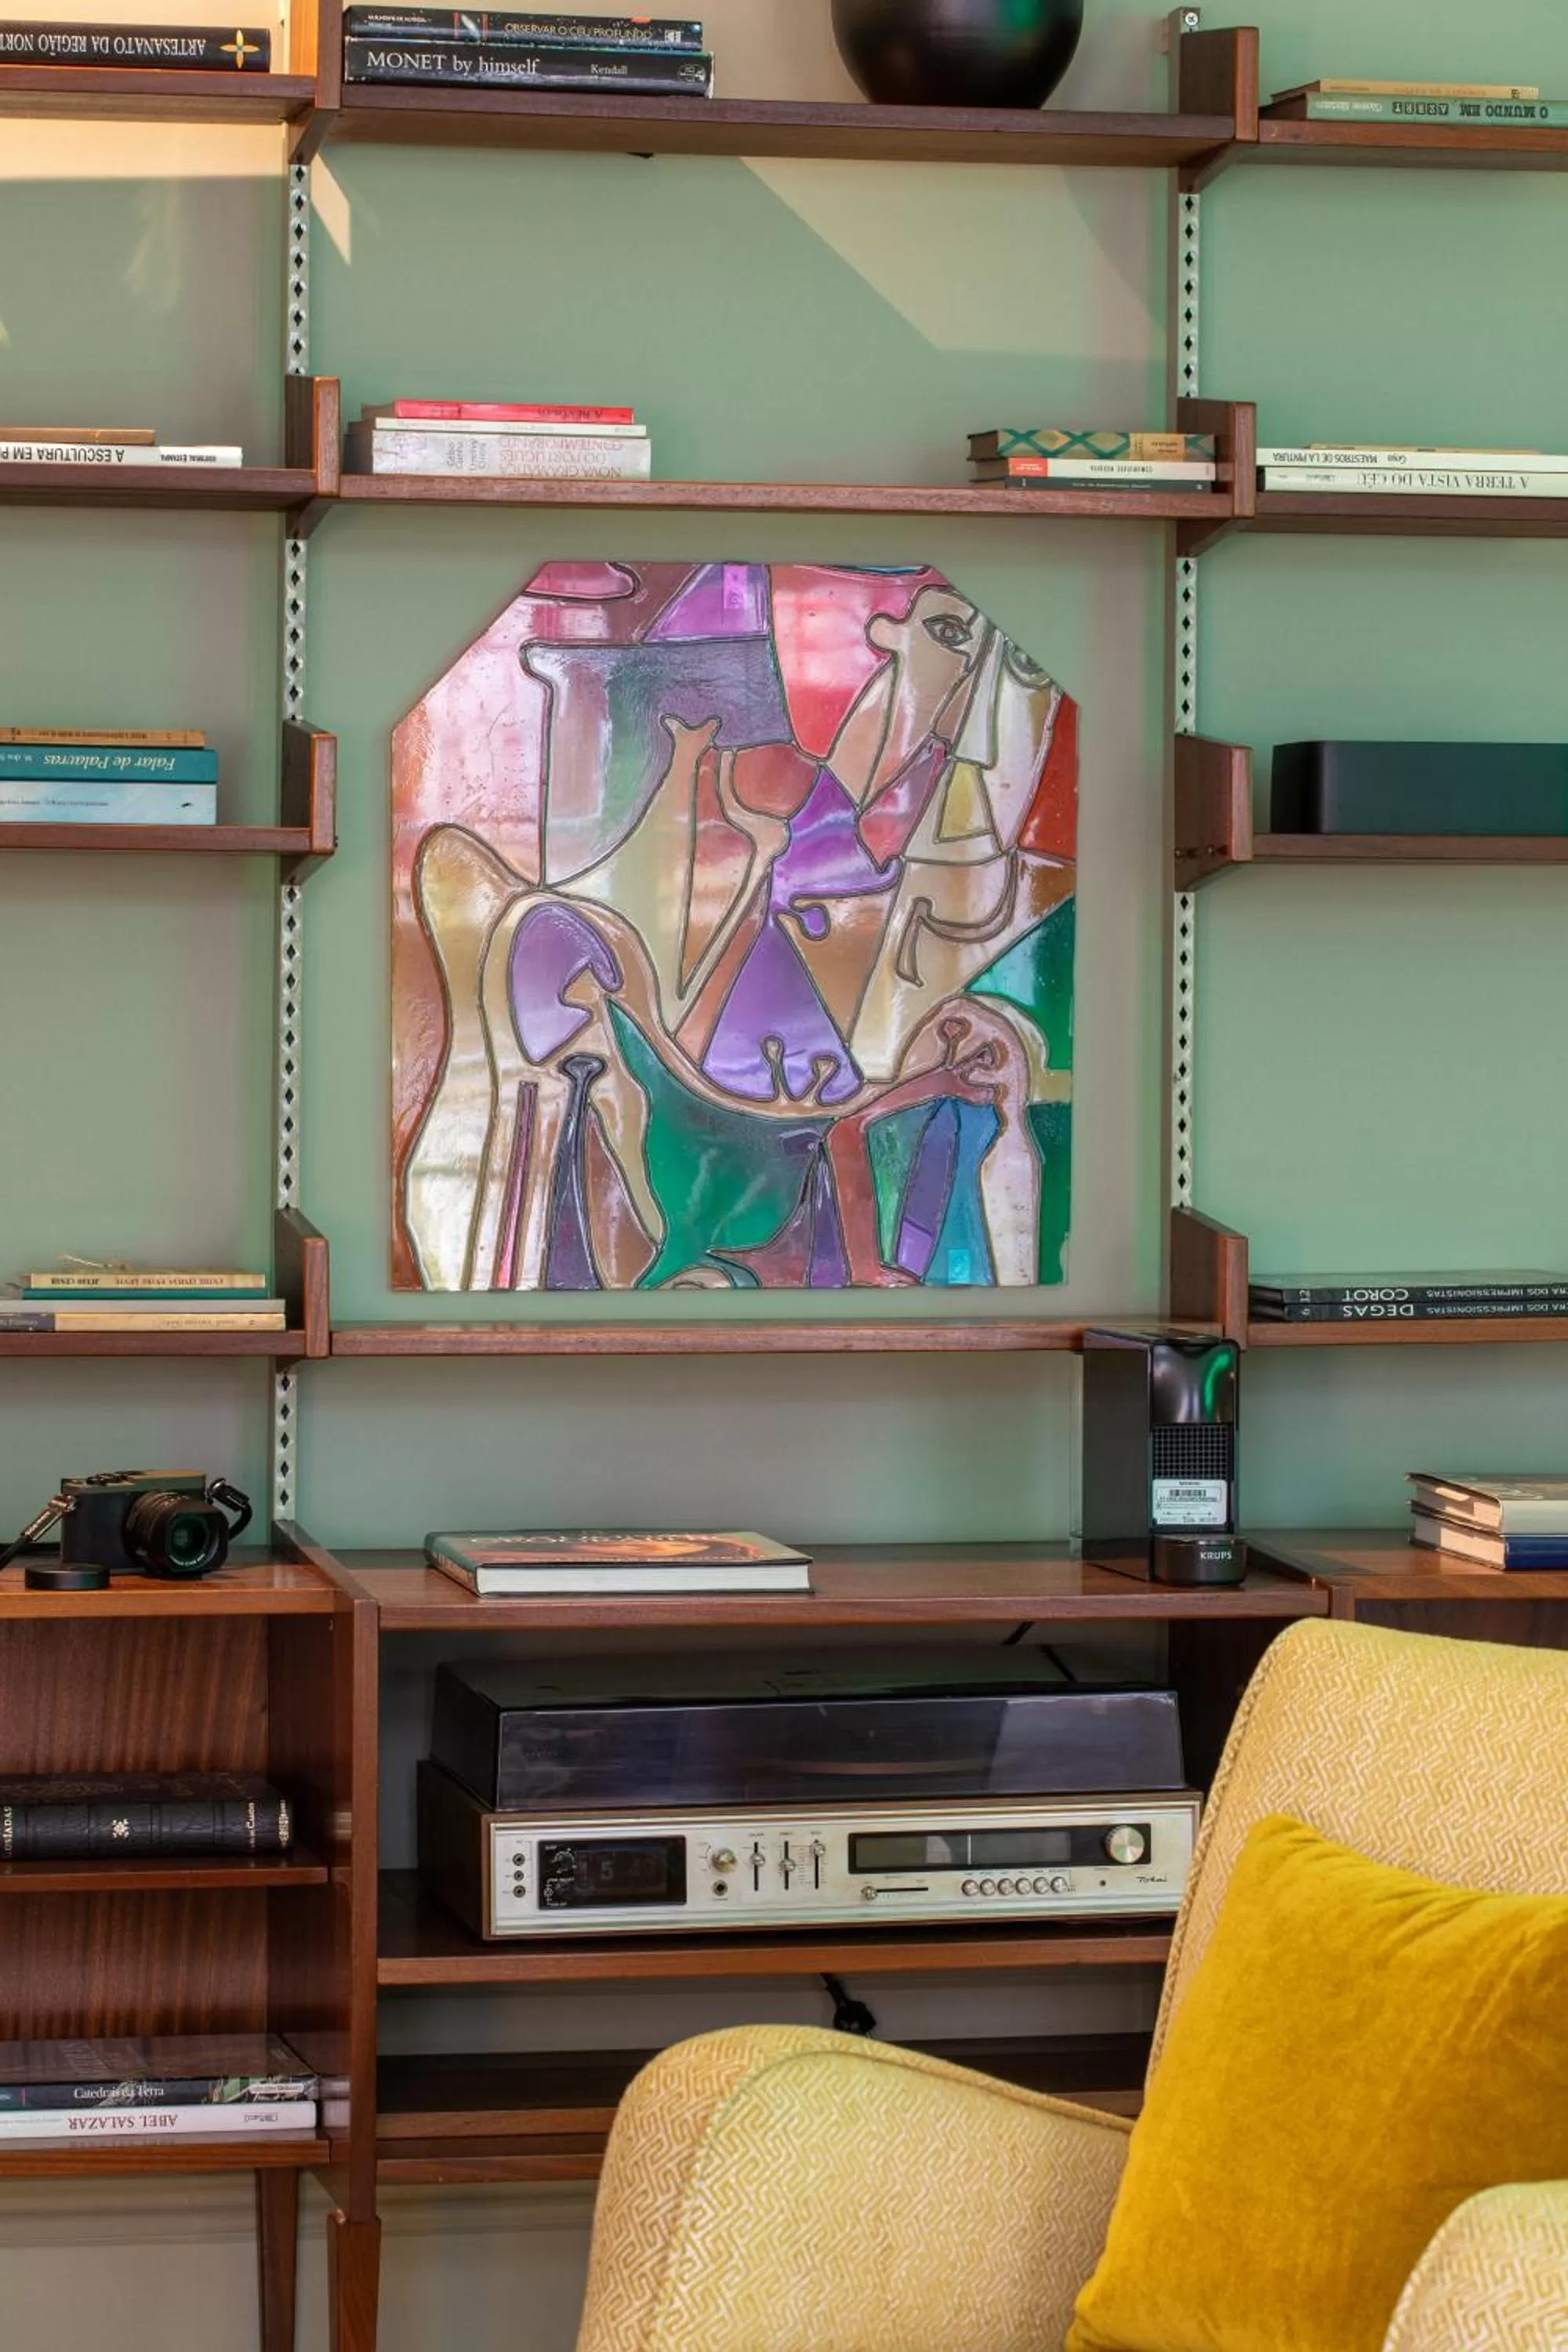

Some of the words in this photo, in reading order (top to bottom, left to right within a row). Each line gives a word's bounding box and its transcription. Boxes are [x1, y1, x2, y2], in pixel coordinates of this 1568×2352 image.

[504, 23, 556, 34] OBSERVAR
[557, 26, 568, 36] O
[38, 34, 87, 58] REGIÃO
[91, 36, 110, 55] DA
[114, 37, 207, 56] ARTESANATO
[366, 50, 447, 71] MONET
[452, 54, 472, 74] by
[479, 56, 540, 75] himself
[590, 63, 628, 76] Kendall
[1485, 104, 1536, 118] MUNDO
[1539, 107, 1549, 118] O
[14, 446, 33, 460] EM
[37, 447, 112, 463] ESCULTURA
[116, 448, 125, 463] A
[1308, 453, 1320, 463] LA
[1334, 454, 1377, 464] MAESTROS
[1391, 473, 1413, 487] DO
[1417, 474, 1461, 488] VISTA
[1465, 474, 1516, 488] TERRA
[1519, 476, 1530, 488] A
[43, 754, 110, 769] Palavras
[113, 755, 132, 771] de
[134, 757, 176, 771] Falar
[1341, 1288, 1409, 1303] COROT
[1426, 1289, 1523, 1298] IMPRESSIONISTAS
[1342, 1304, 1414, 1318] DEGAS
[1426, 1305, 1523, 1315] IMPRESSIONISTAS
[1200, 1551, 1232, 1560] KRUPS
[73, 2086, 119, 2099] Catedrais
[136, 2085, 165, 2097] Terra
[67, 2115, 135, 2131] SALAZAR
[140, 2114, 179, 2128] ABEL
